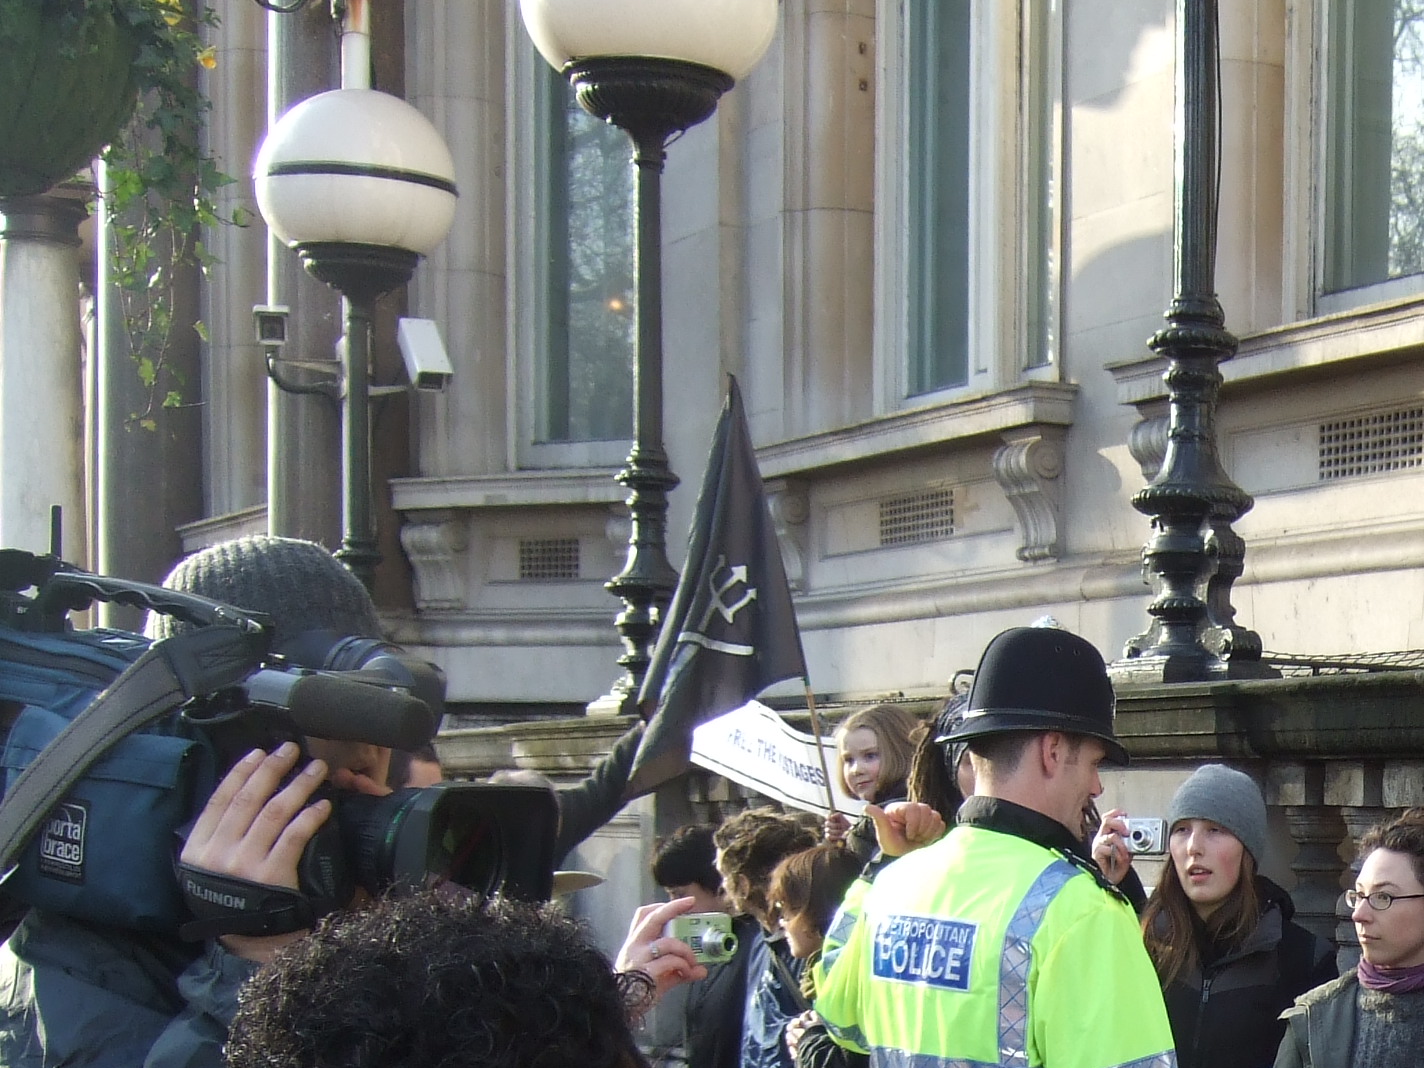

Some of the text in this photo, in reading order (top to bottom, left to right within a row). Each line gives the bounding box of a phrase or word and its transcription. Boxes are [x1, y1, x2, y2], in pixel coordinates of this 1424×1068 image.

[778, 752, 826, 787] STAGES
[44, 836, 80, 861] brace
[879, 918, 970, 943] ETROPOLITAN
[878, 937, 964, 981] POLICE
